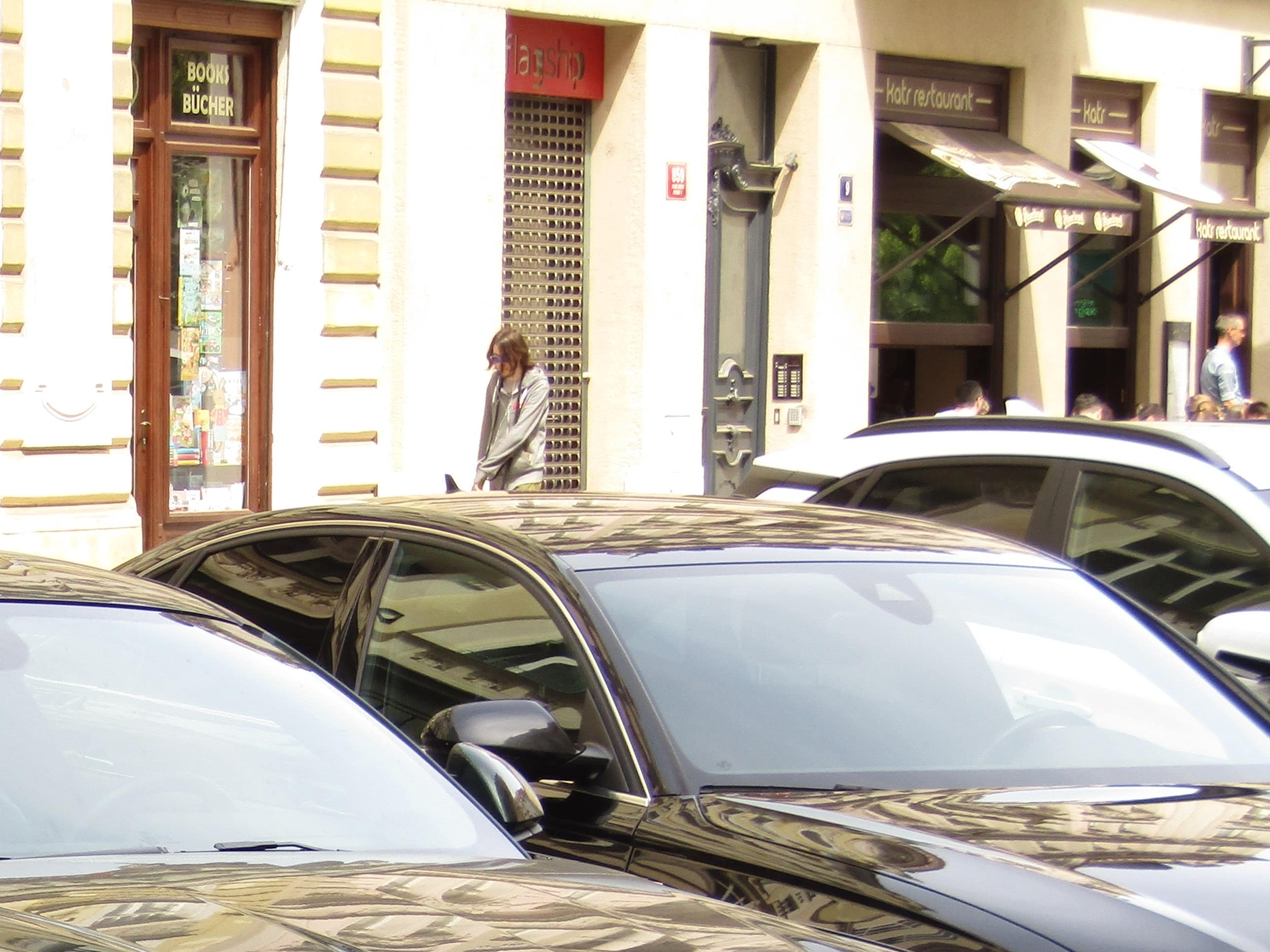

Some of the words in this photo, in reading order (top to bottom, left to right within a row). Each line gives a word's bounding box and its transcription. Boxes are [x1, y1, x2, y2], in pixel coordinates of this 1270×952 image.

[187, 61, 230, 85] BOOKS
[182, 85, 234, 117] BÜCHER
[913, 82, 973, 112] restaurant
[1215, 219, 1261, 242] restaurant
